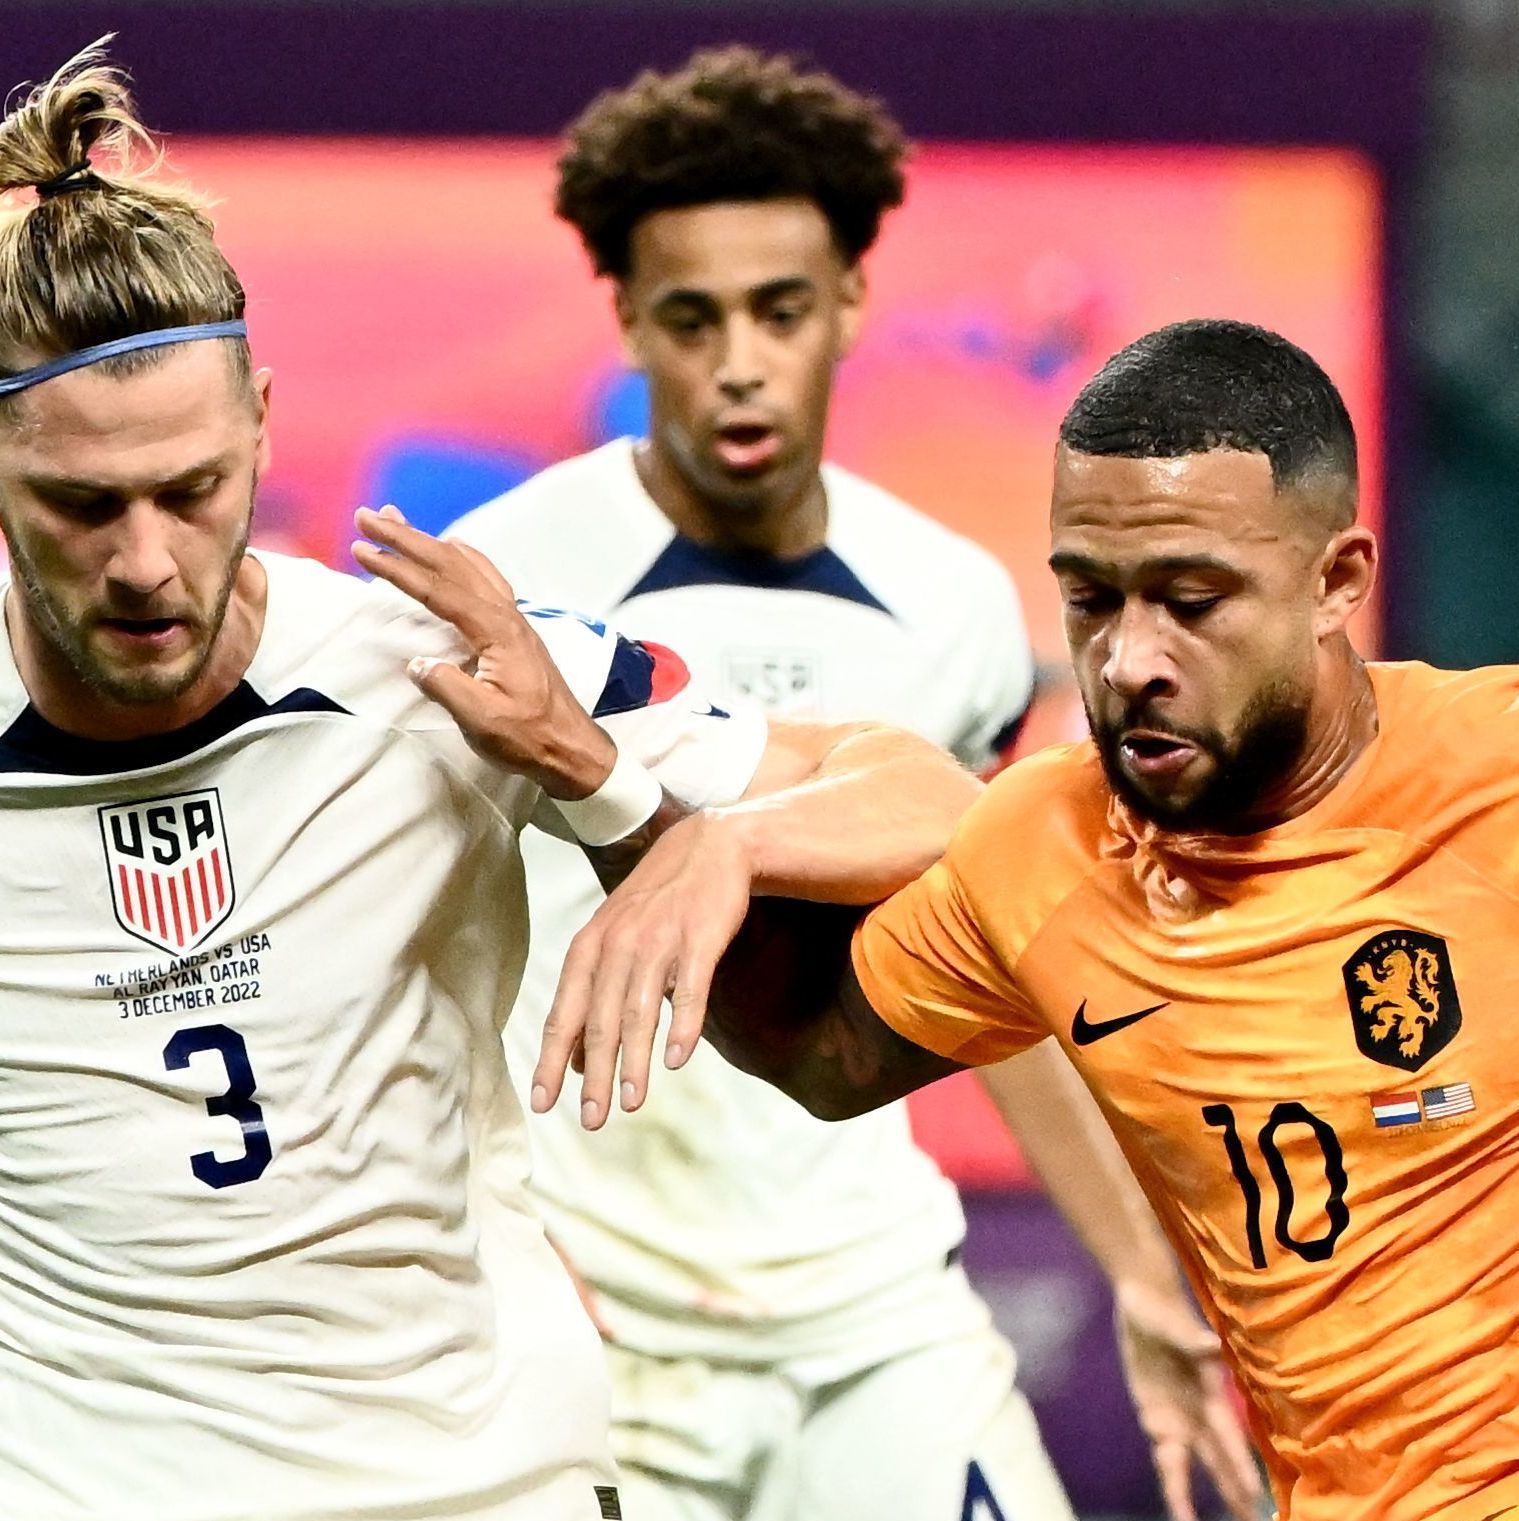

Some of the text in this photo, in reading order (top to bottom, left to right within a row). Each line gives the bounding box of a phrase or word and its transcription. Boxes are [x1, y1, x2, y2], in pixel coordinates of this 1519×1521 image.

[110, 799, 215, 866] USA
[214, 943, 233, 960] VS
[240, 933, 272, 955] USA
[113, 986, 134, 999] AL
[118, 980, 262, 1019] 3 DECEMBER 2022
[162, 1023, 273, 1190] 3
[1201, 1102, 1351, 1270] 10
